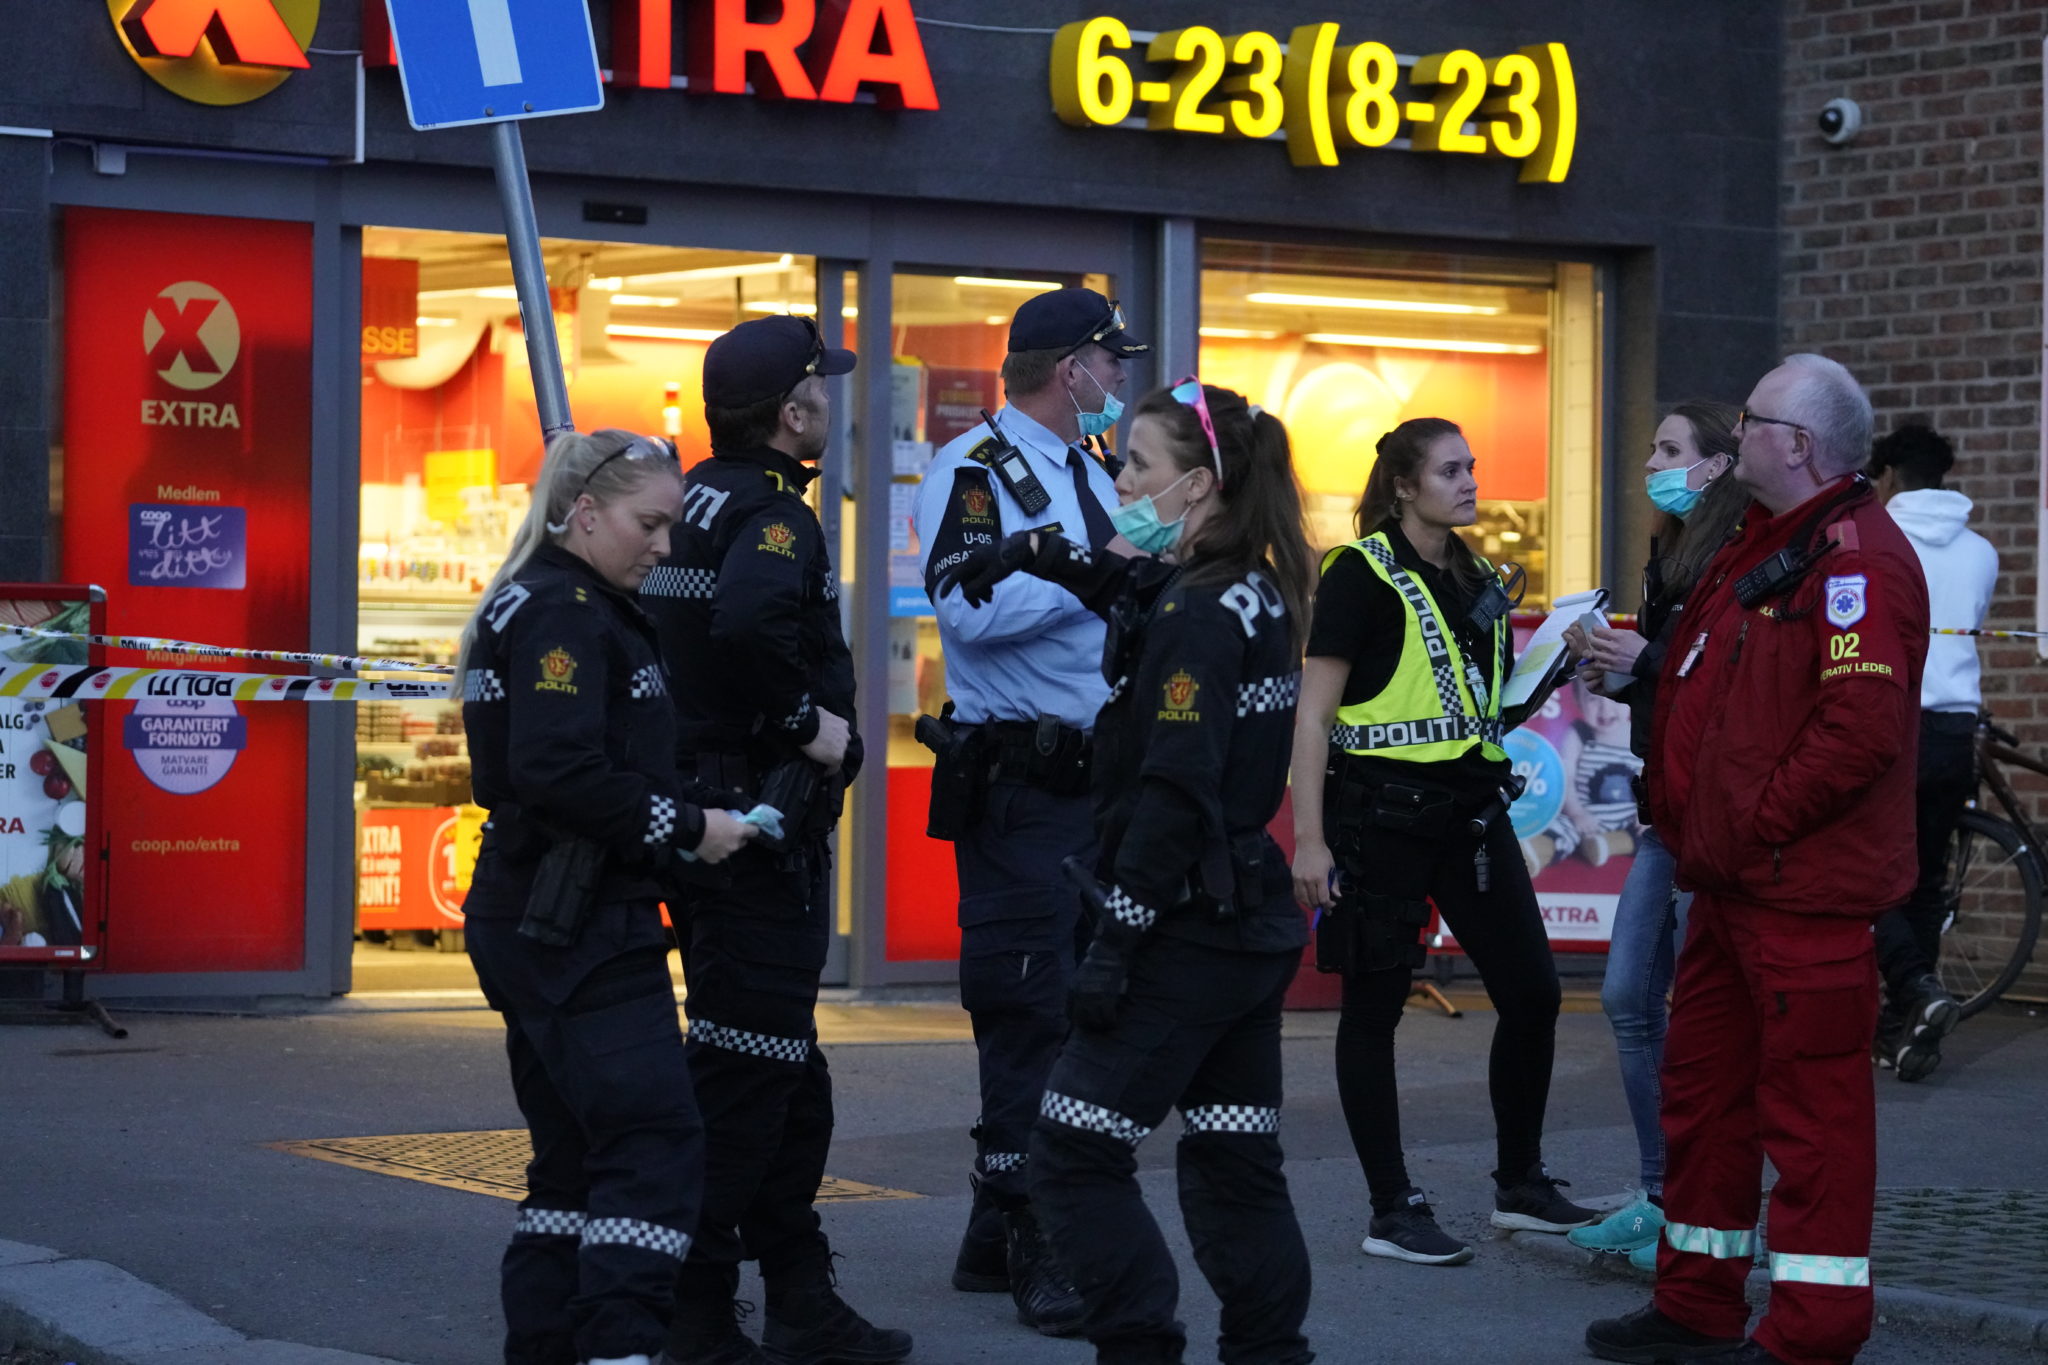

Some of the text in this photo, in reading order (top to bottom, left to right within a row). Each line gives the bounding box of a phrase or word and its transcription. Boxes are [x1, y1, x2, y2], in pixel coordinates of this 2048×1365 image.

[141, 400, 241, 429] EXTRA
[157, 485, 220, 502] Medlem
[961, 516, 994, 526] POLITI
[963, 532, 993, 545] U-05
[758, 543, 796, 560] POLITI
[934, 549, 974, 576] INNSA
[1391, 571, 1448, 659] POLITI
[1830, 632, 1860, 661] 02
[1820, 662, 1892, 681] ERATIV LEDER
[147, 675, 234, 697] POLITI
[535, 681, 578, 694] POLITI
[1158, 710, 1200, 722] POLITI
[141, 717, 230, 733] GARANTERT
[1368, 716, 1460, 750] POLITI
[148, 732, 221, 747] FORNØYD
[161, 755, 209, 765] MATVARE
[162, 766, 207, 776] GARANTI
[131, 836, 240, 855] coop.no/extra
[1540, 906, 1599, 923] XTRA
